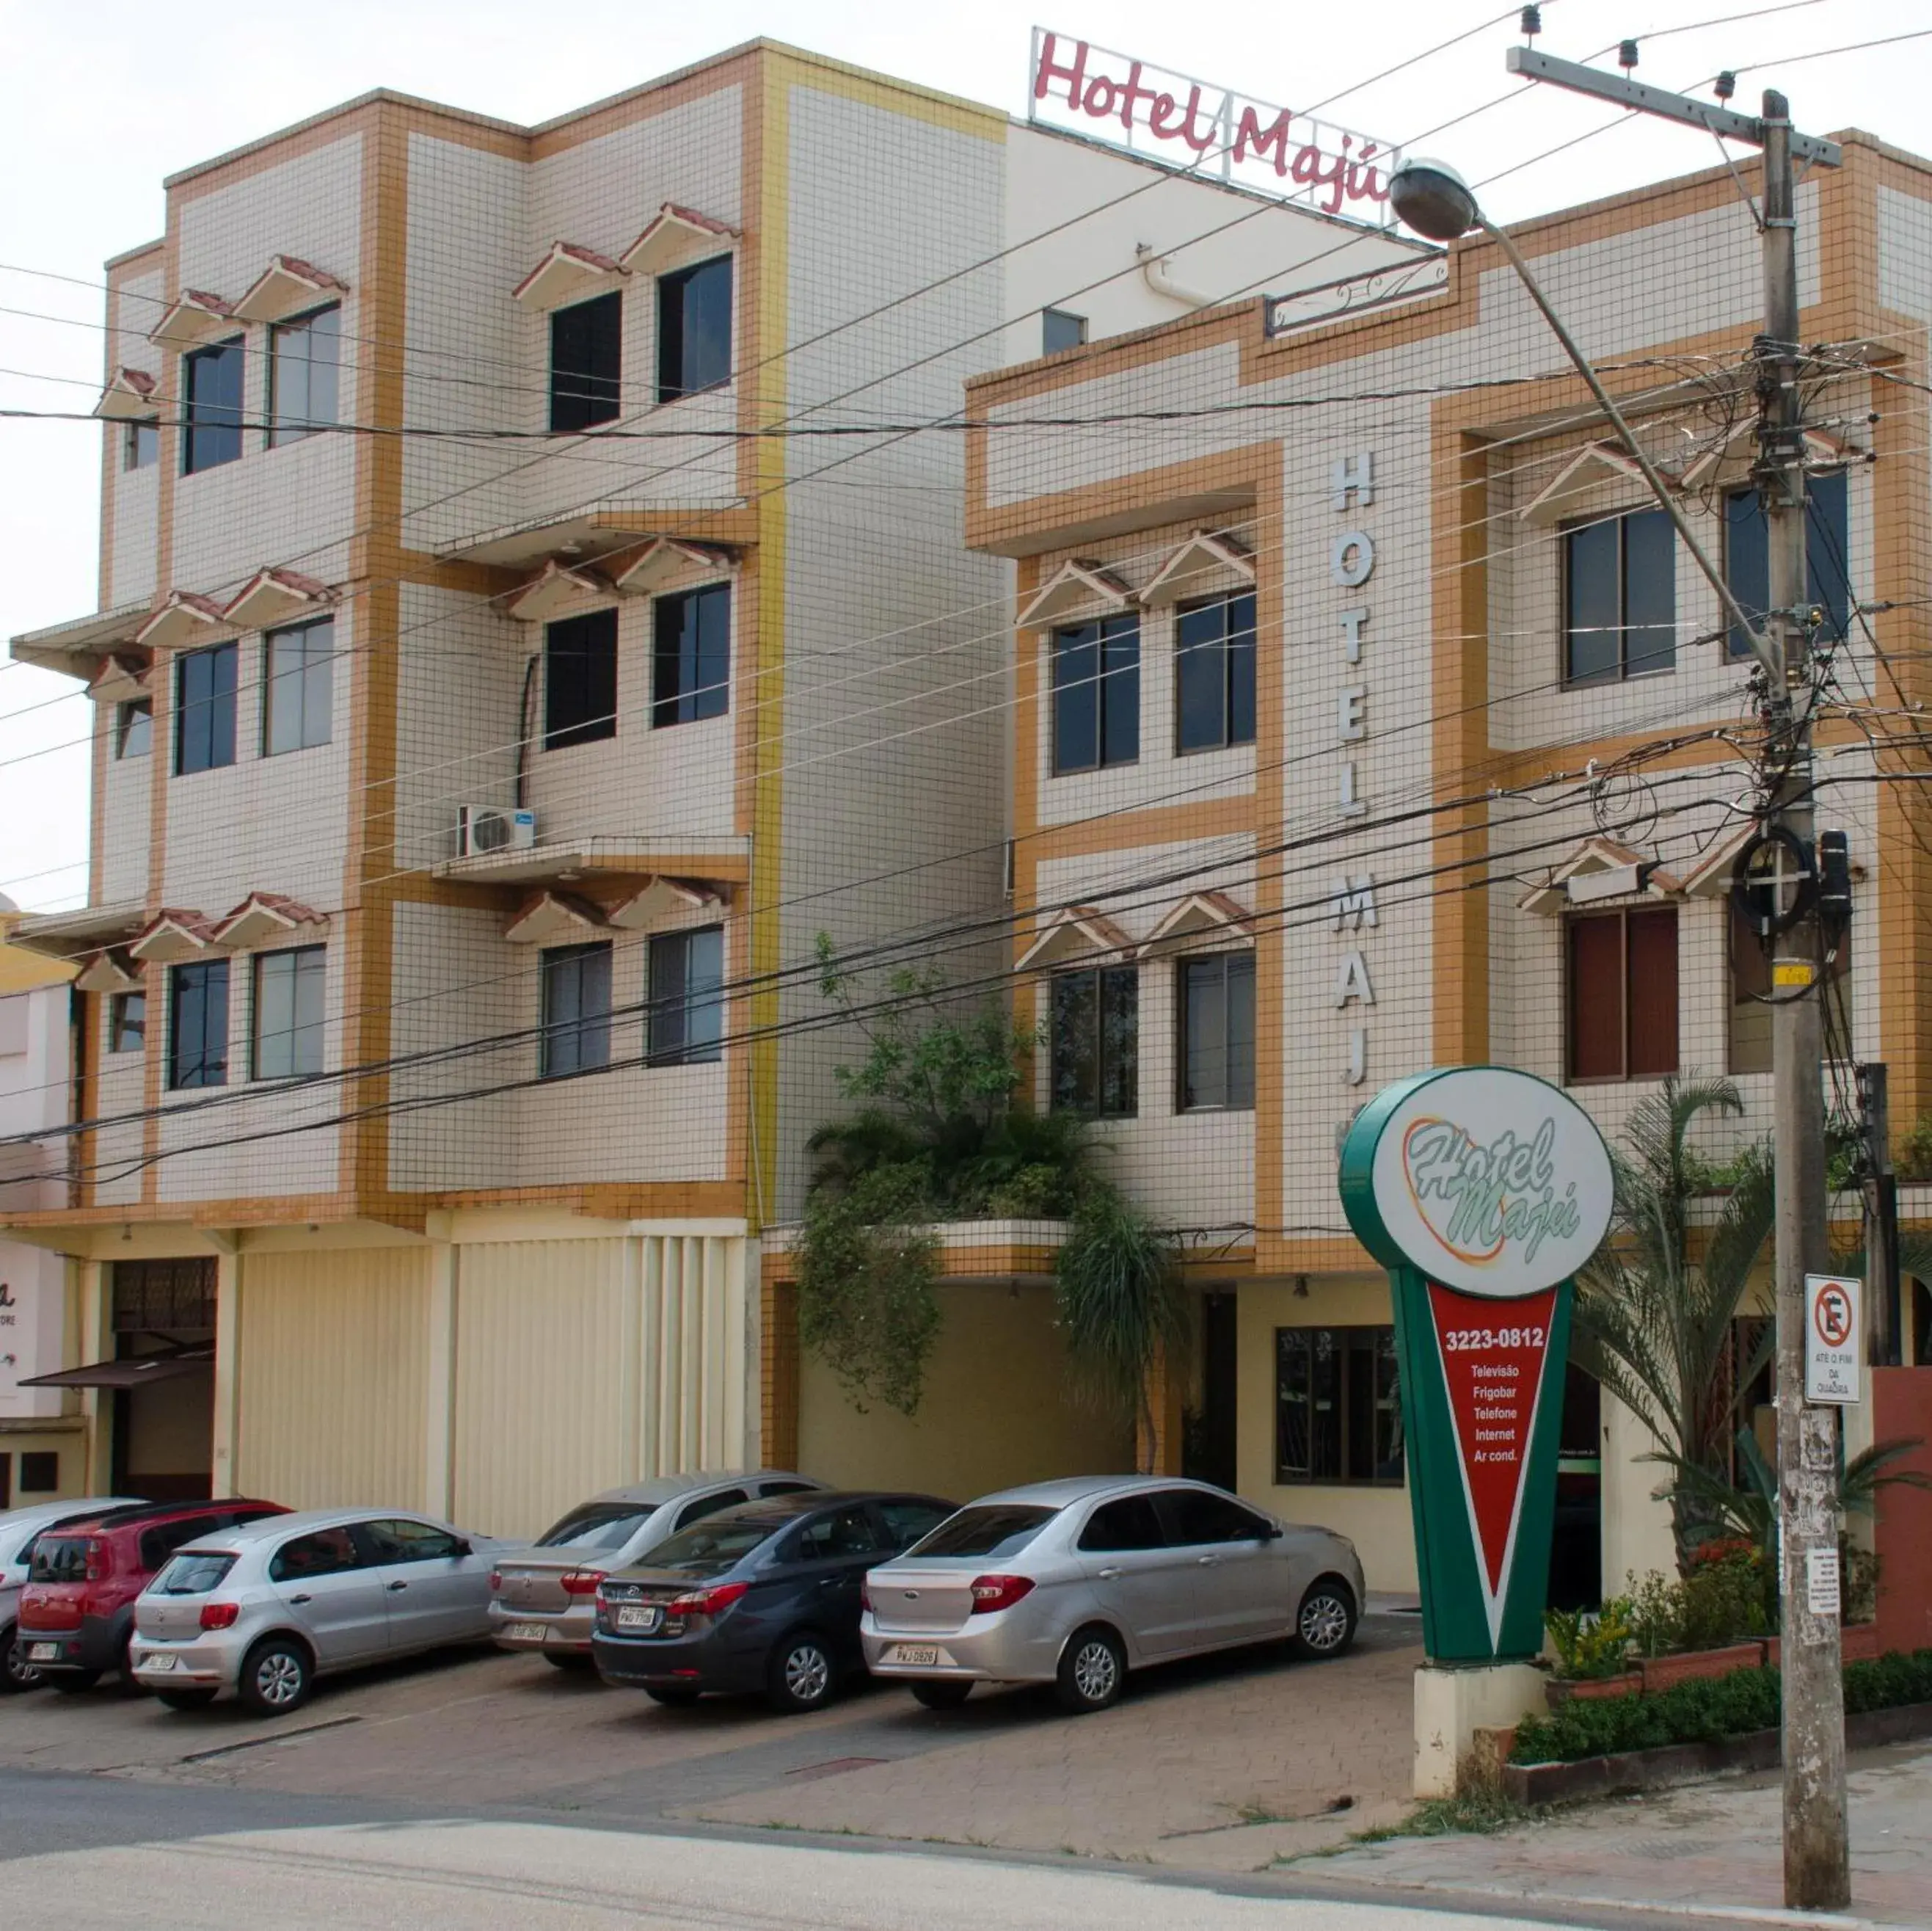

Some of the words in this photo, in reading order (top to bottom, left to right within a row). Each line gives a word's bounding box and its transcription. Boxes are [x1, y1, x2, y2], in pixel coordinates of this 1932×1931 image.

[1034, 32, 1217, 150] Hotel
[1233, 106, 1392, 214] Majú
[1330, 451, 1377, 818] HOTEL
[1332, 873, 1379, 1152] MAJ
[1409, 1116, 1556, 1200] Hotel
[1446, 1327, 1545, 1351] 3223-0812
[1470, 1364, 1520, 1378] Televisão
[1473, 1386, 1517, 1401] Frigobar
[1473, 1407, 1517, 1420] Telefone
[1476, 1429, 1515, 1441] Internet
[1474, 1450, 1487, 1462] Ar
[1489, 1449, 1517, 1461] cond.
